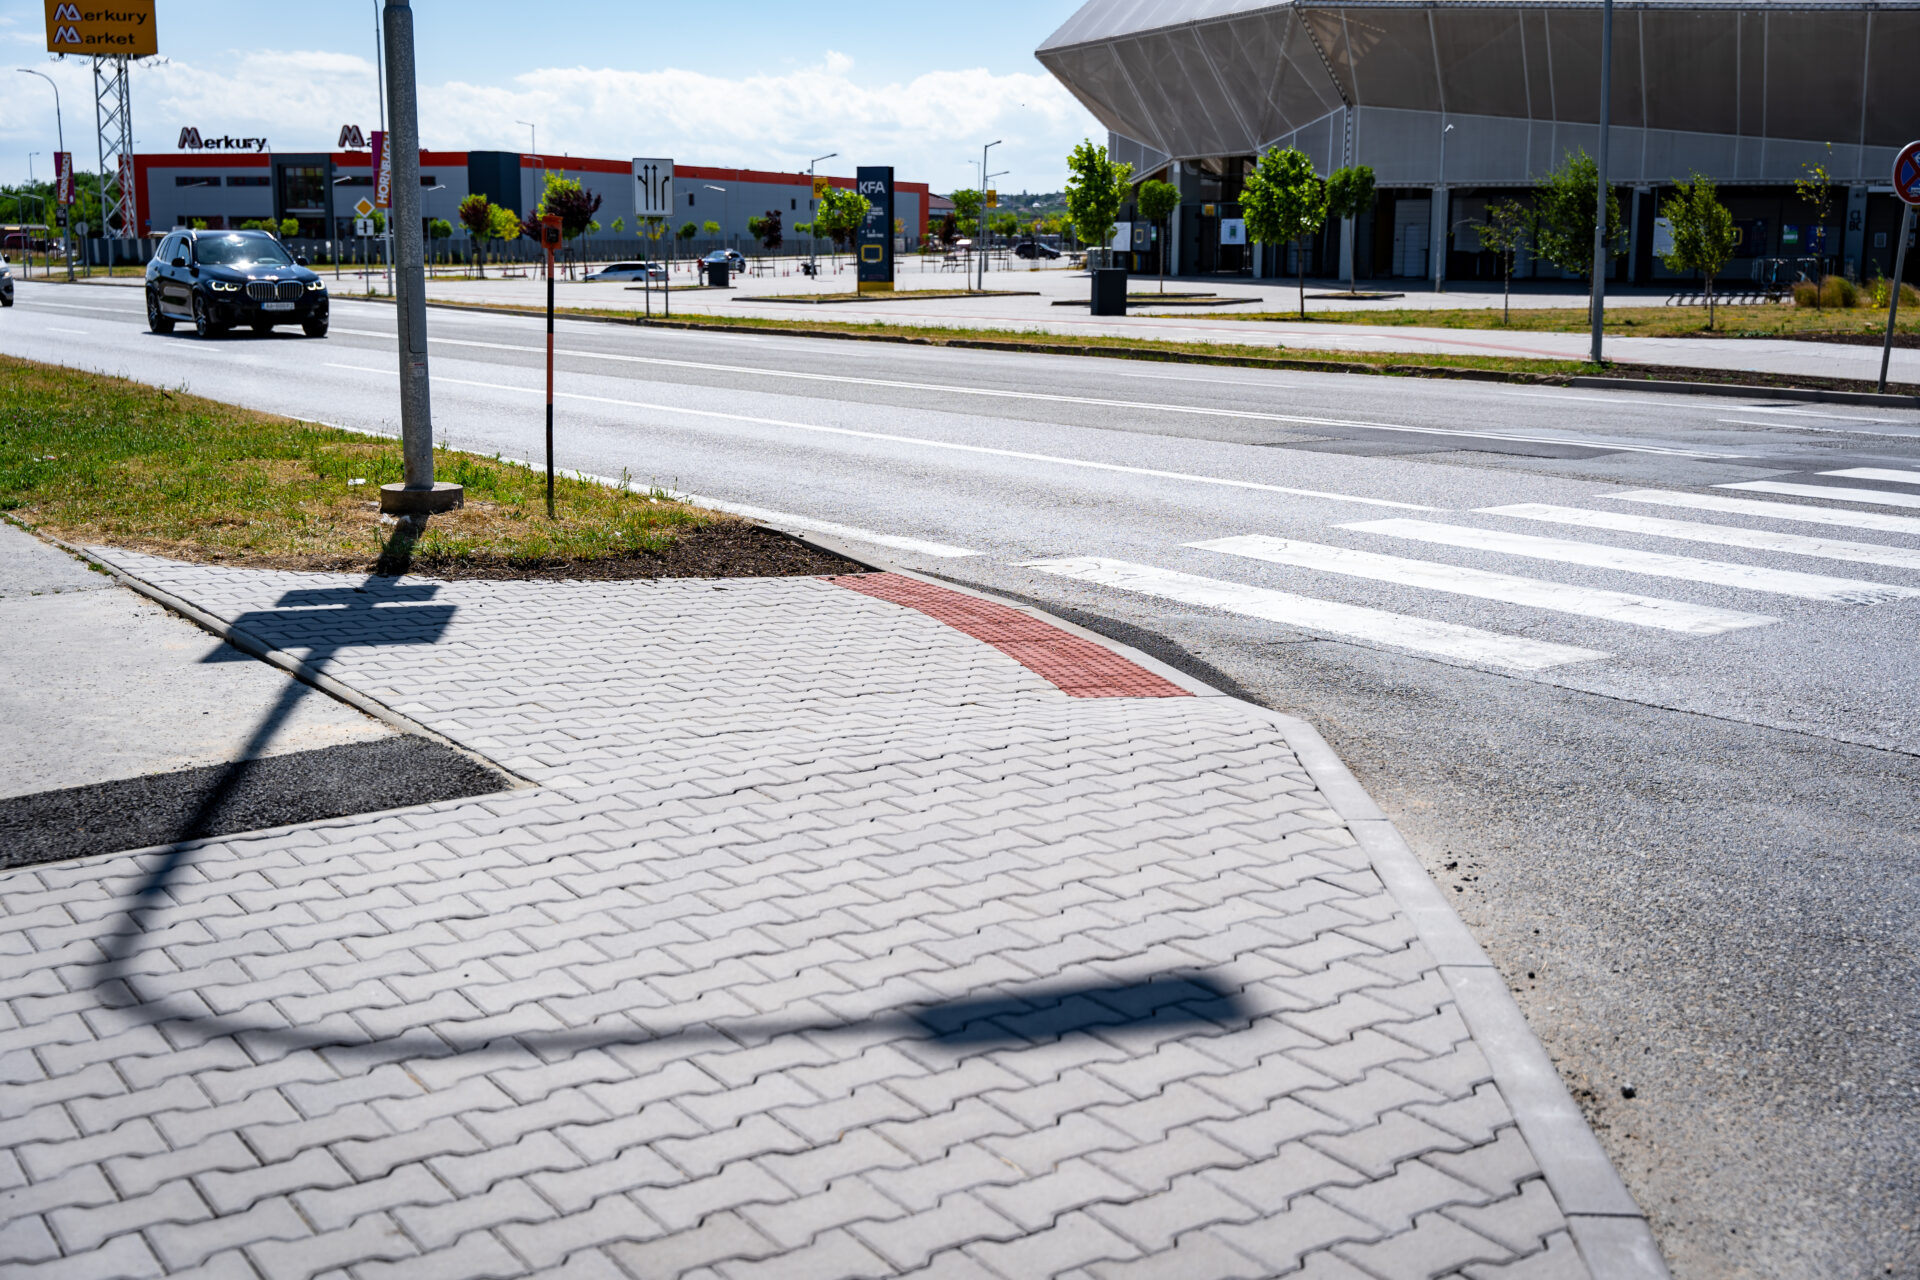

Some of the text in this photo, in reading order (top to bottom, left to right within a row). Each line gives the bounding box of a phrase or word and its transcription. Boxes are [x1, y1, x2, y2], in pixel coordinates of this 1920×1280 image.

[54, 3, 147, 25] Merkury
[53, 25, 136, 44] Market
[178, 127, 267, 152] Merkury
[858, 181, 886, 194] KFA
